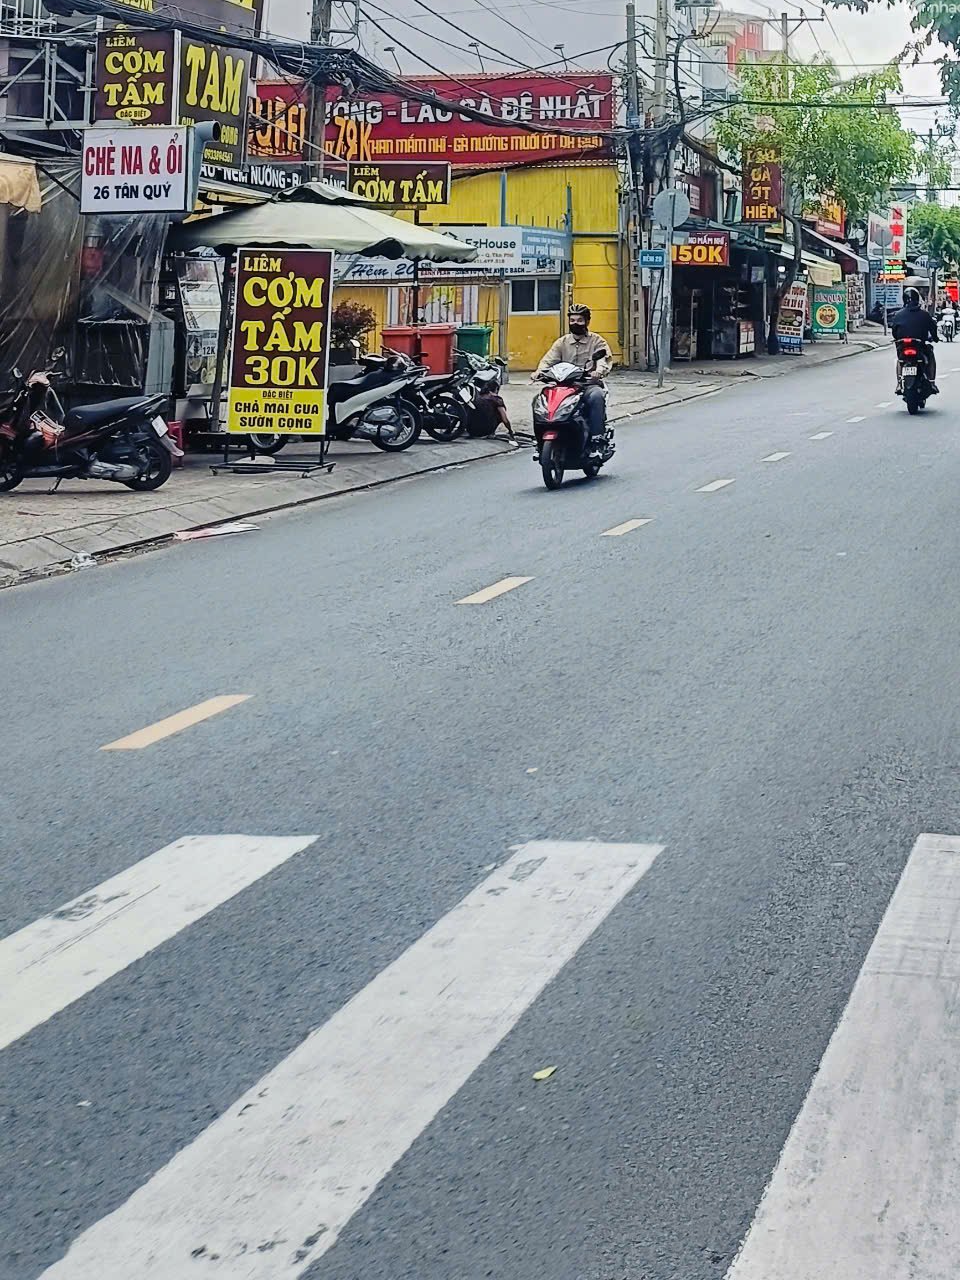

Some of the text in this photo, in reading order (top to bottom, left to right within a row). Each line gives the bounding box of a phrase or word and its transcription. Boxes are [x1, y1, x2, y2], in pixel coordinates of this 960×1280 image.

[104, 47, 165, 74] CƠM
[103, 73, 165, 106] TẤM
[539, 83, 605, 119] NHẤT
[85, 132, 183, 176] CHÈ NA & ỔI
[353, 164, 380, 176] LIÊM
[93, 181, 172, 200] 26 TÂN QUÝ
[352, 175, 395, 203] CƠM
[399, 169, 444, 203] TẤM
[243, 253, 282, 272] LIÊM
[243, 271, 325, 308] CƠM
[240, 306, 324, 352] TẤM
[244, 355, 320, 386] 30K
[234, 401, 319, 415] CHẢ MAI CUA
[239, 414, 313, 431] SƯỜN CỌNG
